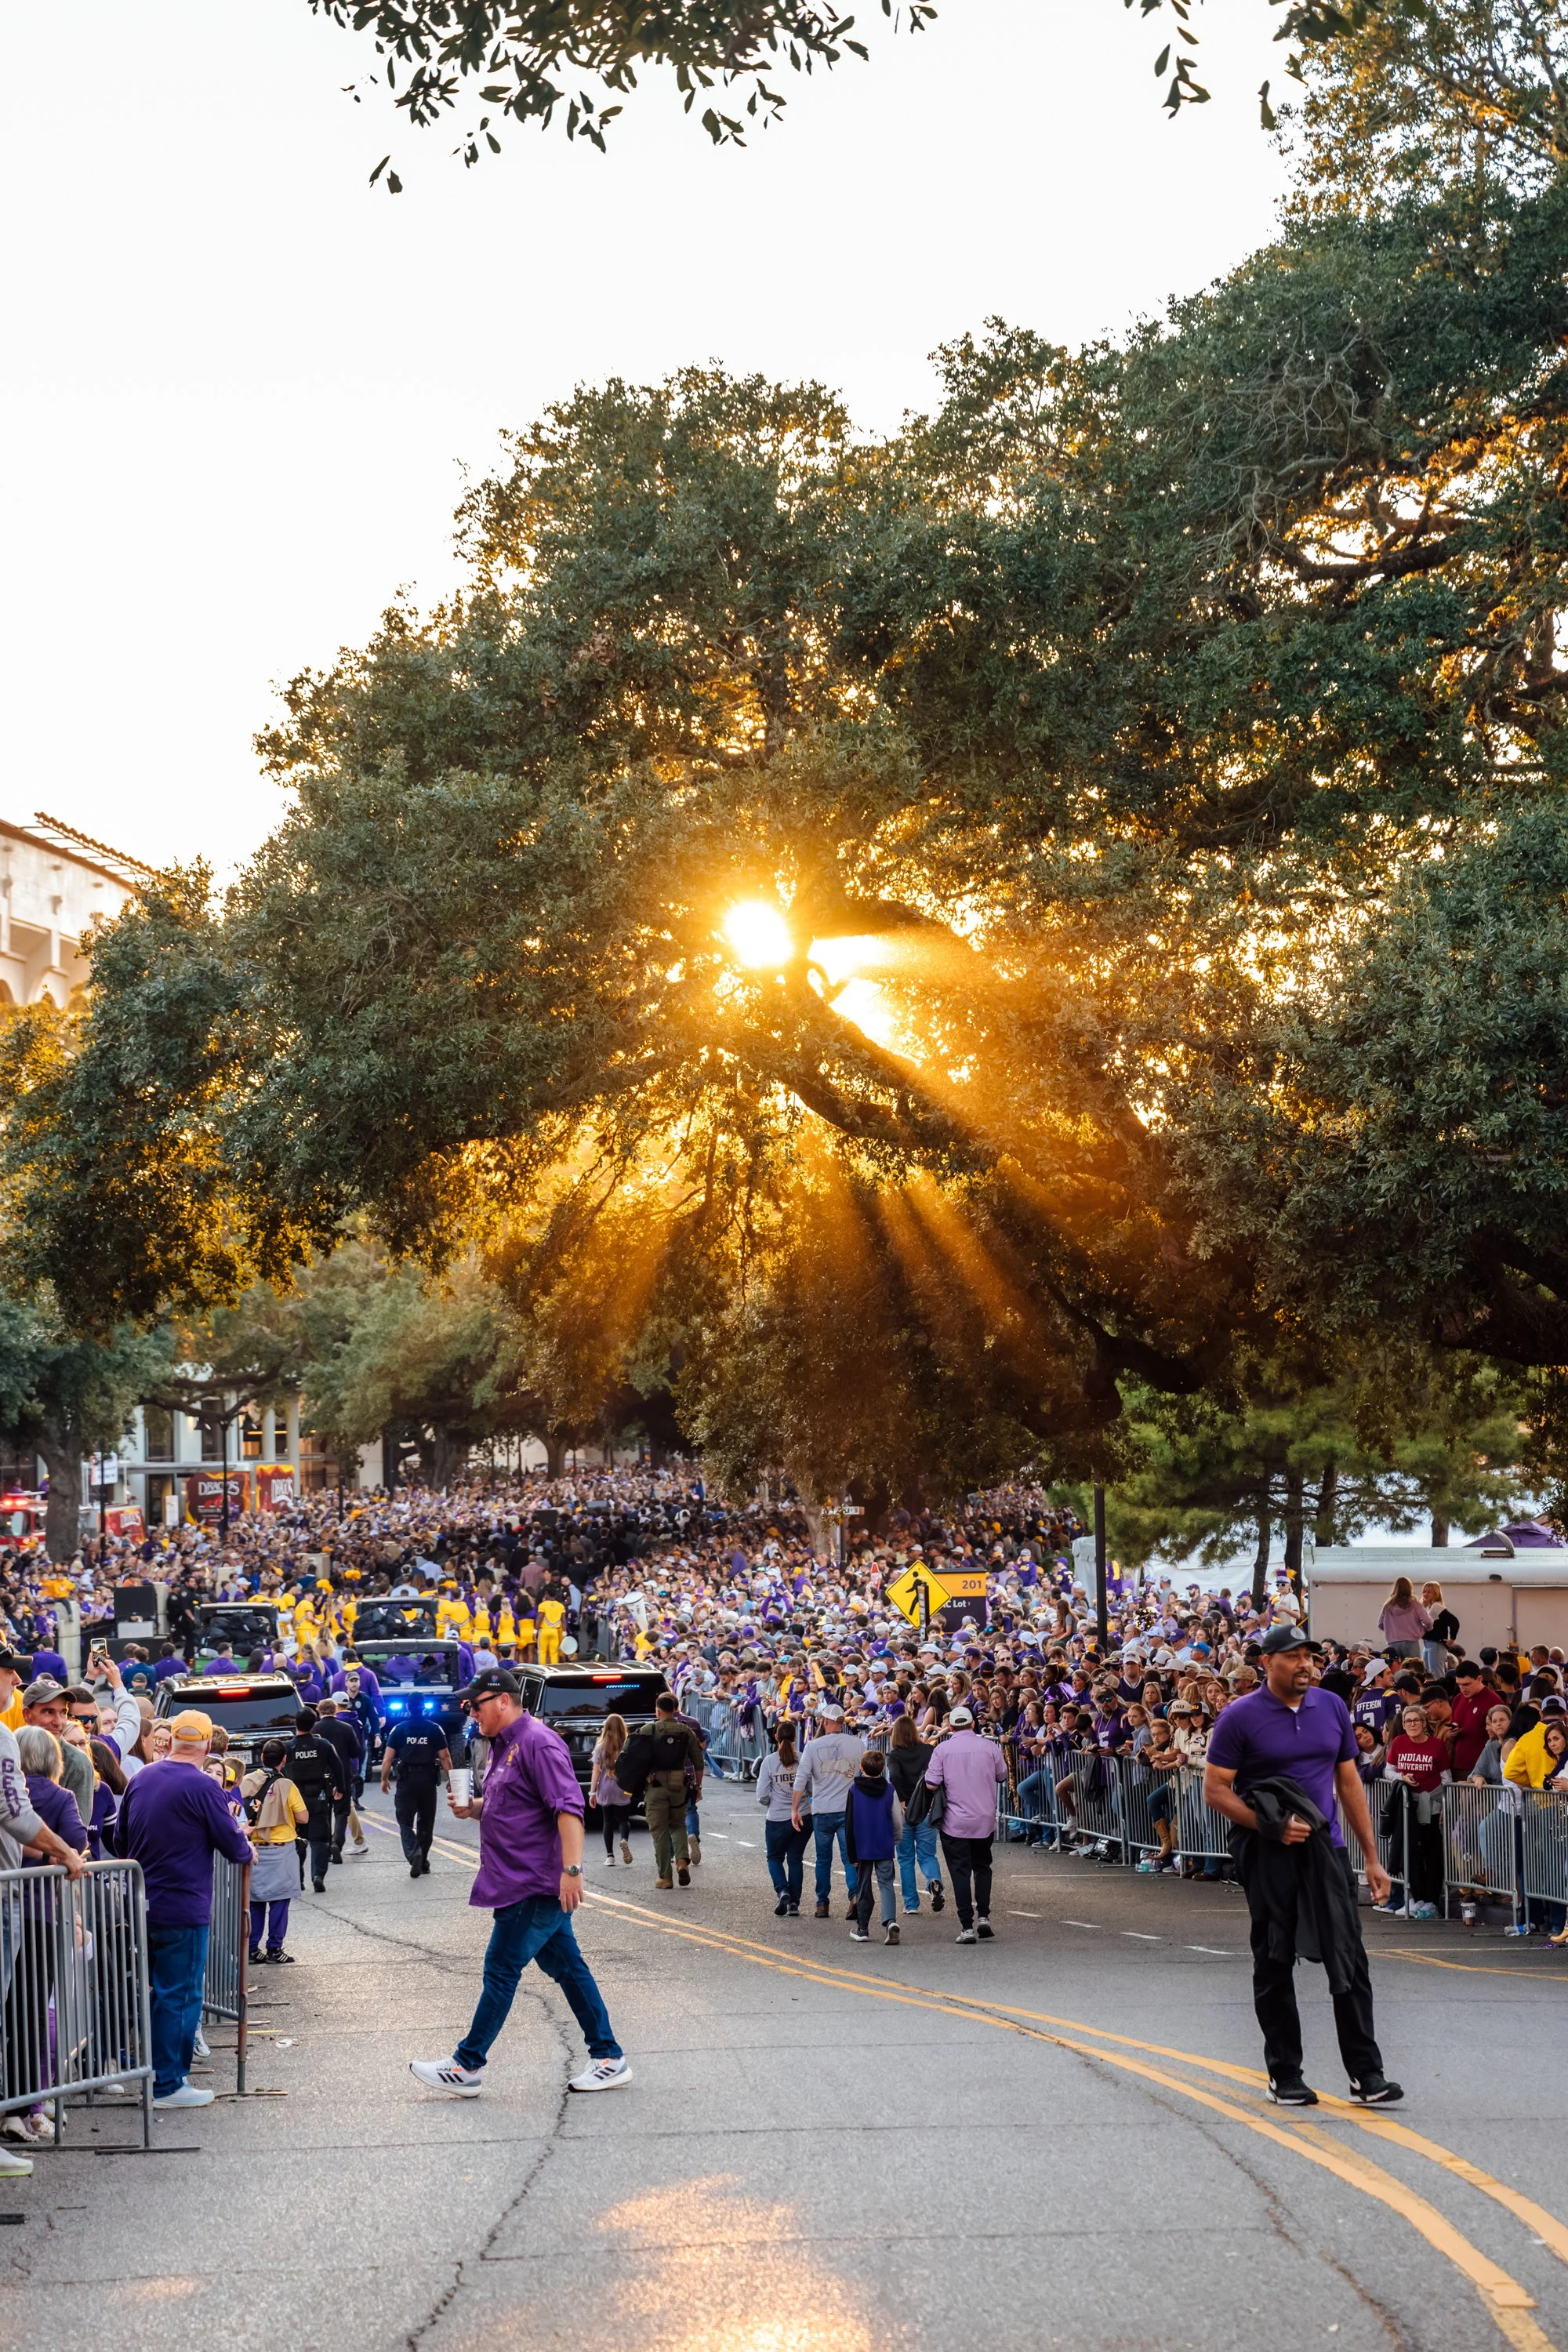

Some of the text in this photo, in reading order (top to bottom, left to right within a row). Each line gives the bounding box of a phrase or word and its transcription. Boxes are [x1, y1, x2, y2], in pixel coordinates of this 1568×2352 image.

[962, 1580, 982, 1589] 201
[1356, 1700, 1381, 1712] EFFERSON
[295, 1750, 318, 1759] POLICE
[1398, 1753, 1433, 1764] INDIANA
[1397, 1762, 1433, 1771] UNIVERSITY
[773, 1773, 796, 1782] TIGE
